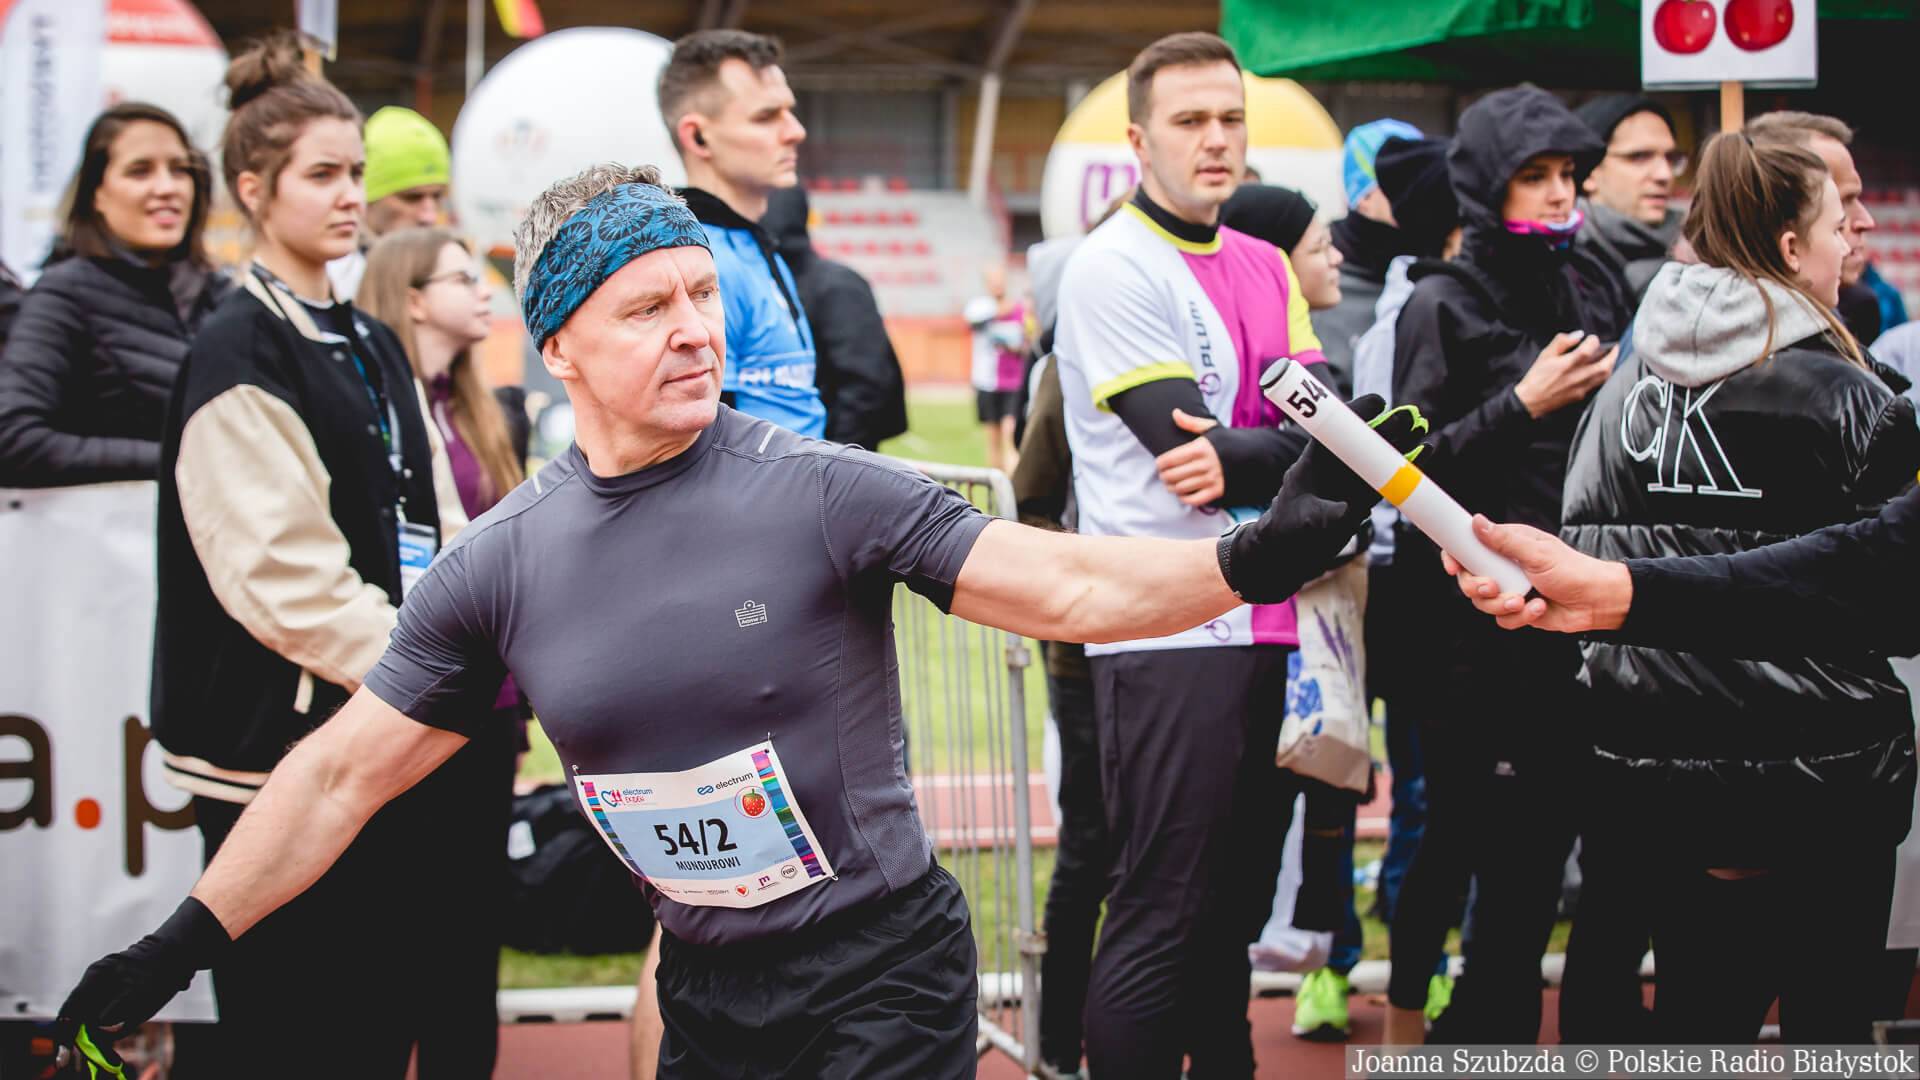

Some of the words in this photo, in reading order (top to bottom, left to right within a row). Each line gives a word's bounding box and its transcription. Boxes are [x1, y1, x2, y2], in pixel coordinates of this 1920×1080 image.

[1286, 378, 1329, 419] 54
[1621, 375, 1763, 498] CK
[622, 788, 653, 796] electrum
[715, 772, 754, 790] electrum
[653, 818, 738, 856] 54/2
[675, 856, 741, 871] MUNDUROWI
